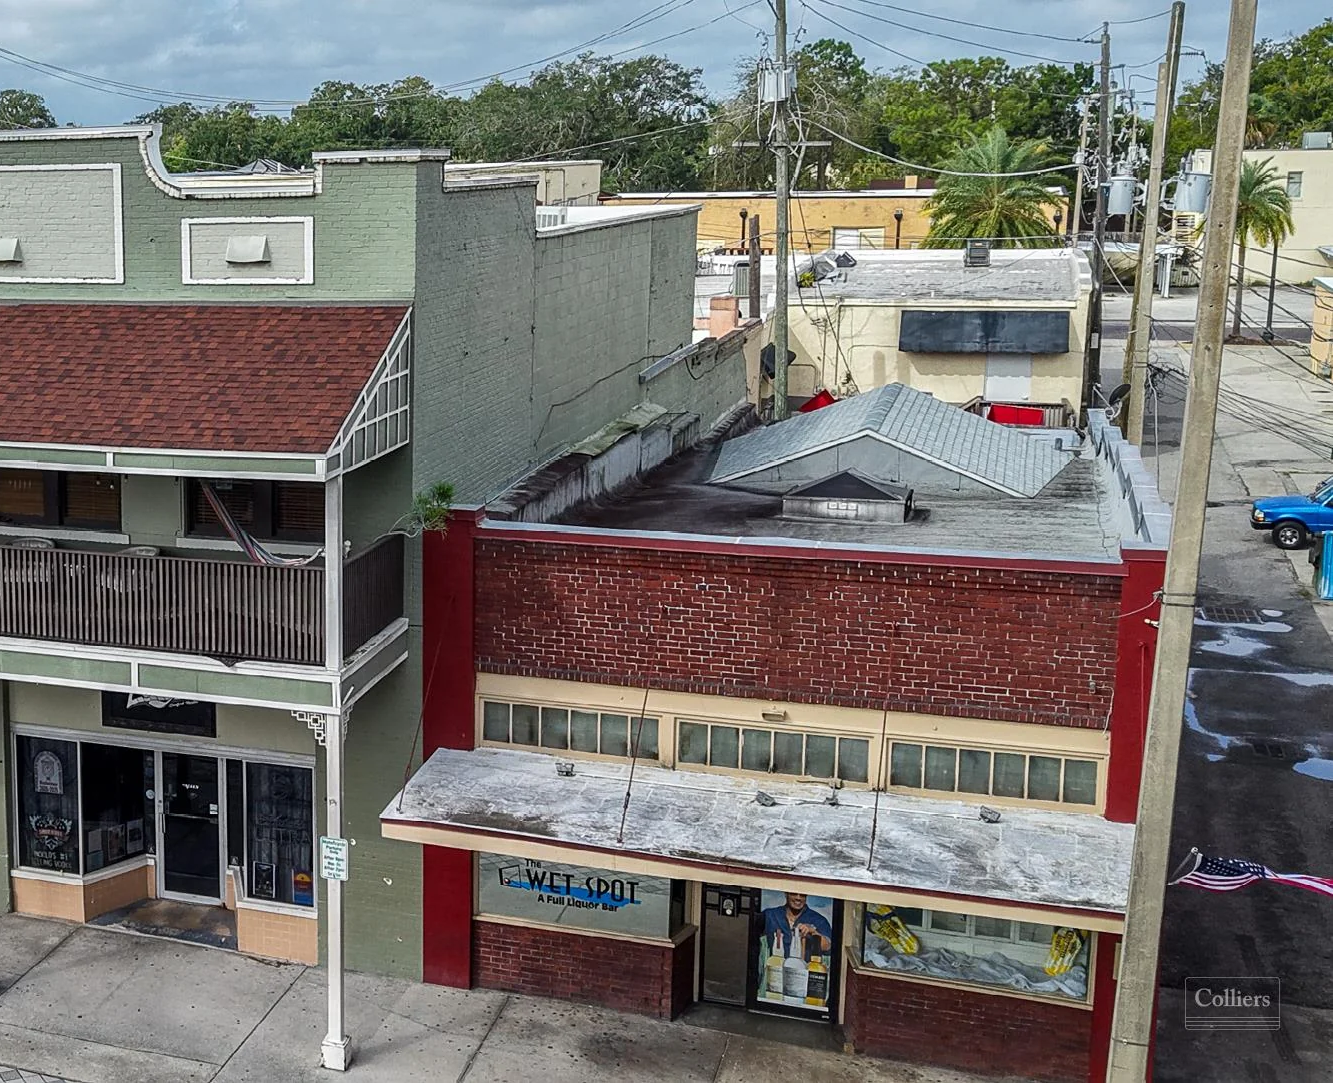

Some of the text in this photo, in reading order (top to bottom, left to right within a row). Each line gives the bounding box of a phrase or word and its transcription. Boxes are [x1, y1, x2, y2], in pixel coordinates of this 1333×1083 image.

[525, 858, 542, 868] The
[525, 868, 639, 904] WET SPOT
[537, 894, 619, 912] A Full Liquor Bar
